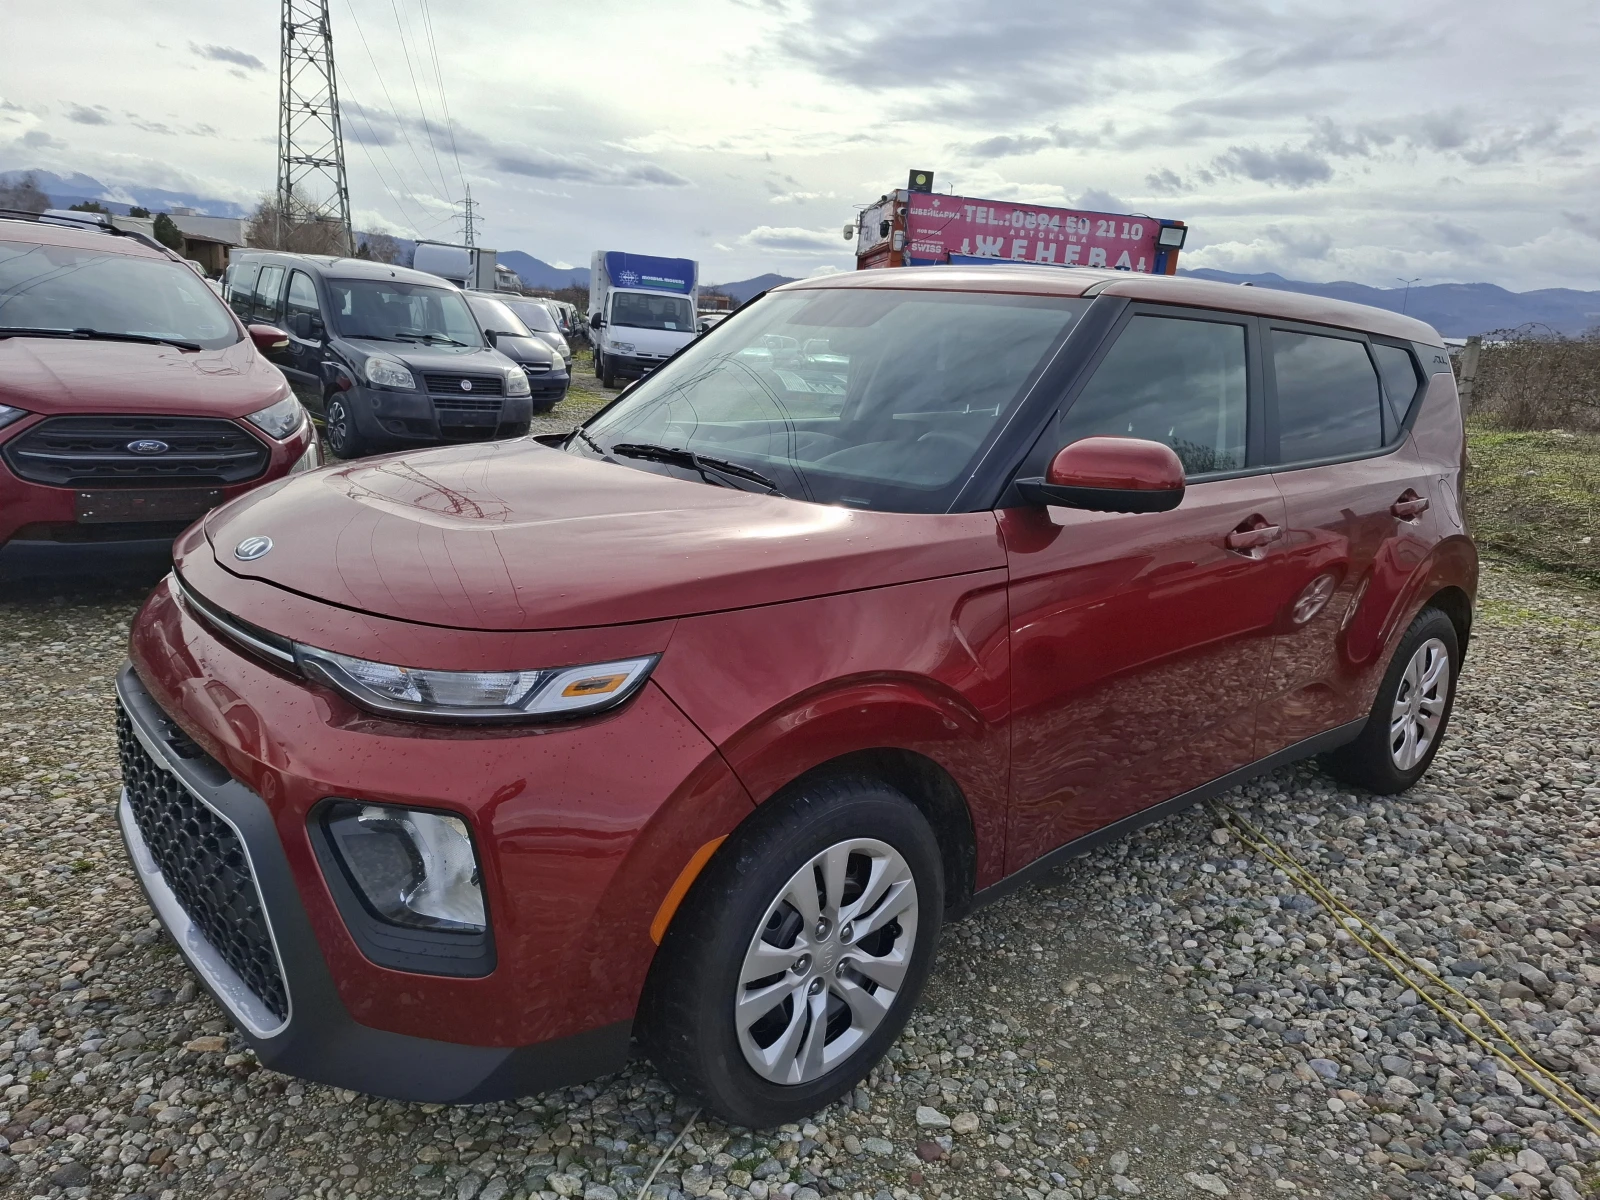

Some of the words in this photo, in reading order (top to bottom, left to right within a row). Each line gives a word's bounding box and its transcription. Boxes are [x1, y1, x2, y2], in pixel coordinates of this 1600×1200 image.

[1010, 228, 1087, 243] АВТОКЪЩА
[1065, 216, 1090, 235] 50
[1095, 220, 1116, 238] 21
[1121, 222, 1143, 241] 10
[911, 243, 942, 254] SWISS
[975, 235, 1132, 271] ЖЕНЕВА
